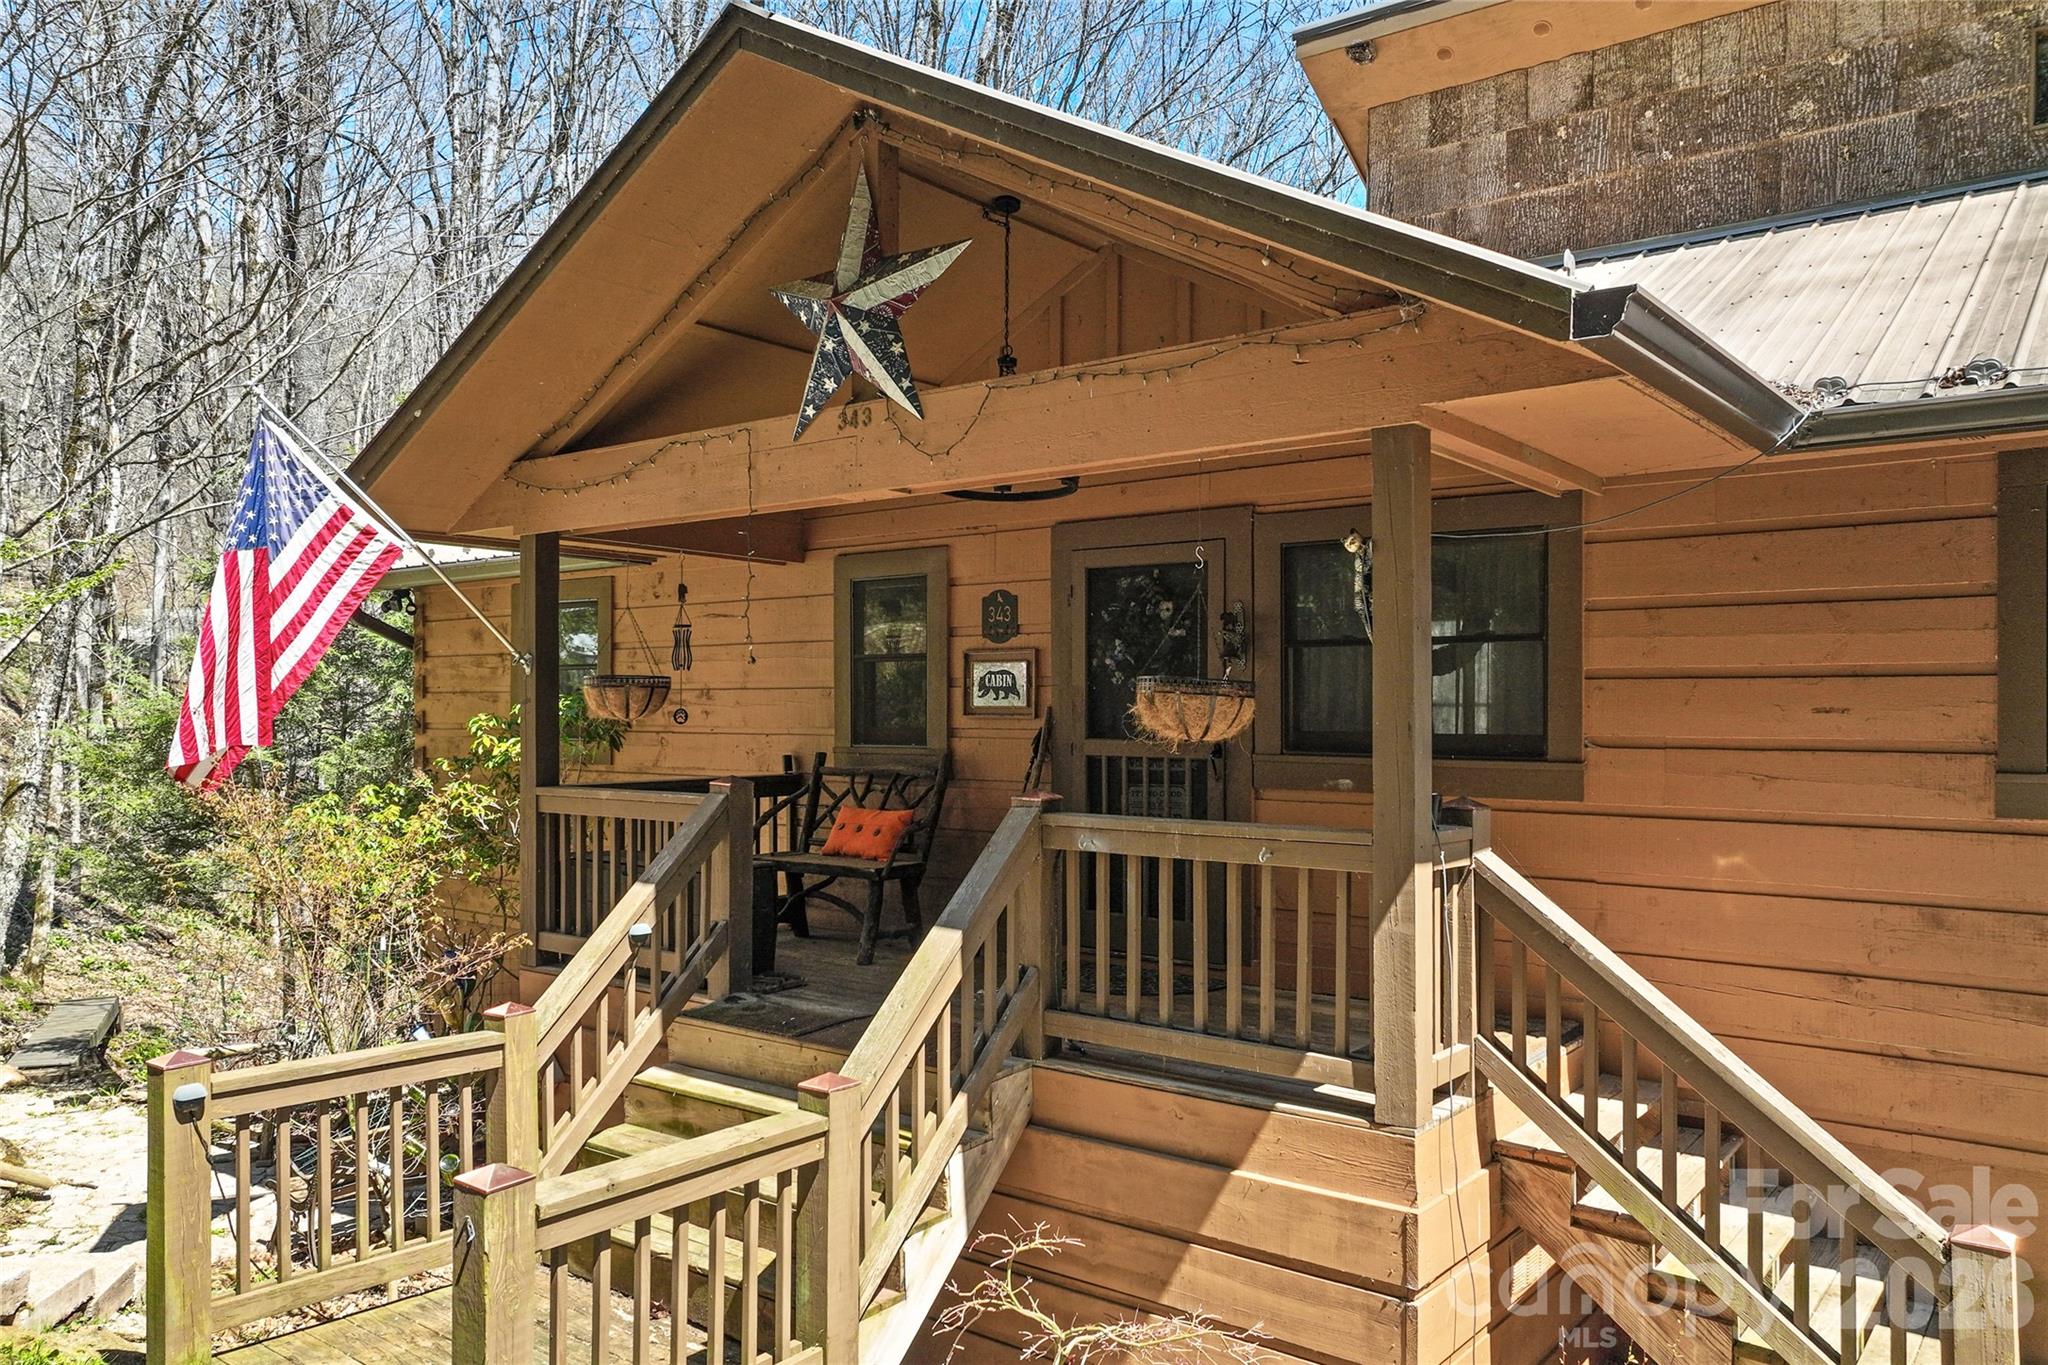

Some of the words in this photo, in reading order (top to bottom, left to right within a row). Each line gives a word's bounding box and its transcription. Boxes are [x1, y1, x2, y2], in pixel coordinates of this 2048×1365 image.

[838, 407, 872, 430] 343
[988, 605, 1011, 622] 343
[985, 674, 1013, 687] CABIN
